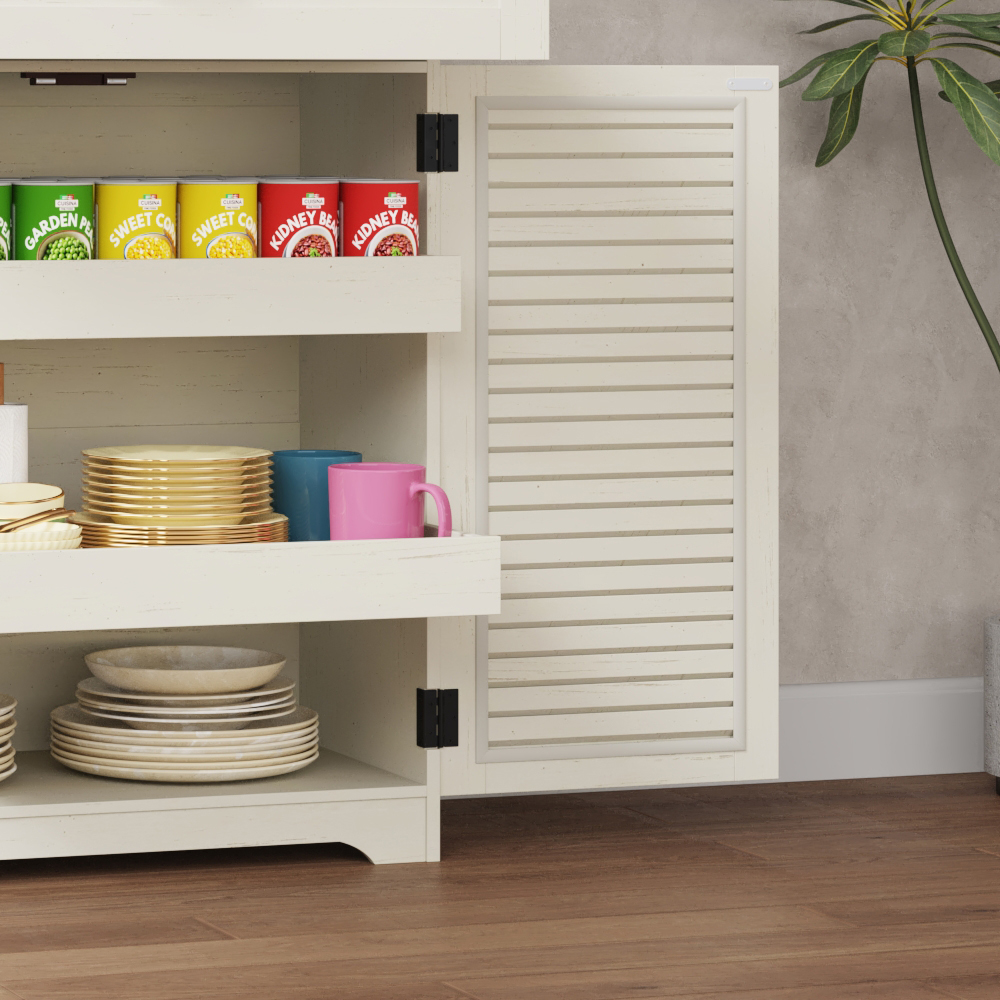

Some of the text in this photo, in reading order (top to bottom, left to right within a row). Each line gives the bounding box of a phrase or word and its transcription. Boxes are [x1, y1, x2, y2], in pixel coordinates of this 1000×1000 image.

[24, 212, 78, 251] GARDEN
[109, 211, 153, 248] SWEET
[191, 211, 235, 247] SWEET
[269, 210, 317, 251] KIDNEY
[352, 209, 399, 250] KIDNEY
